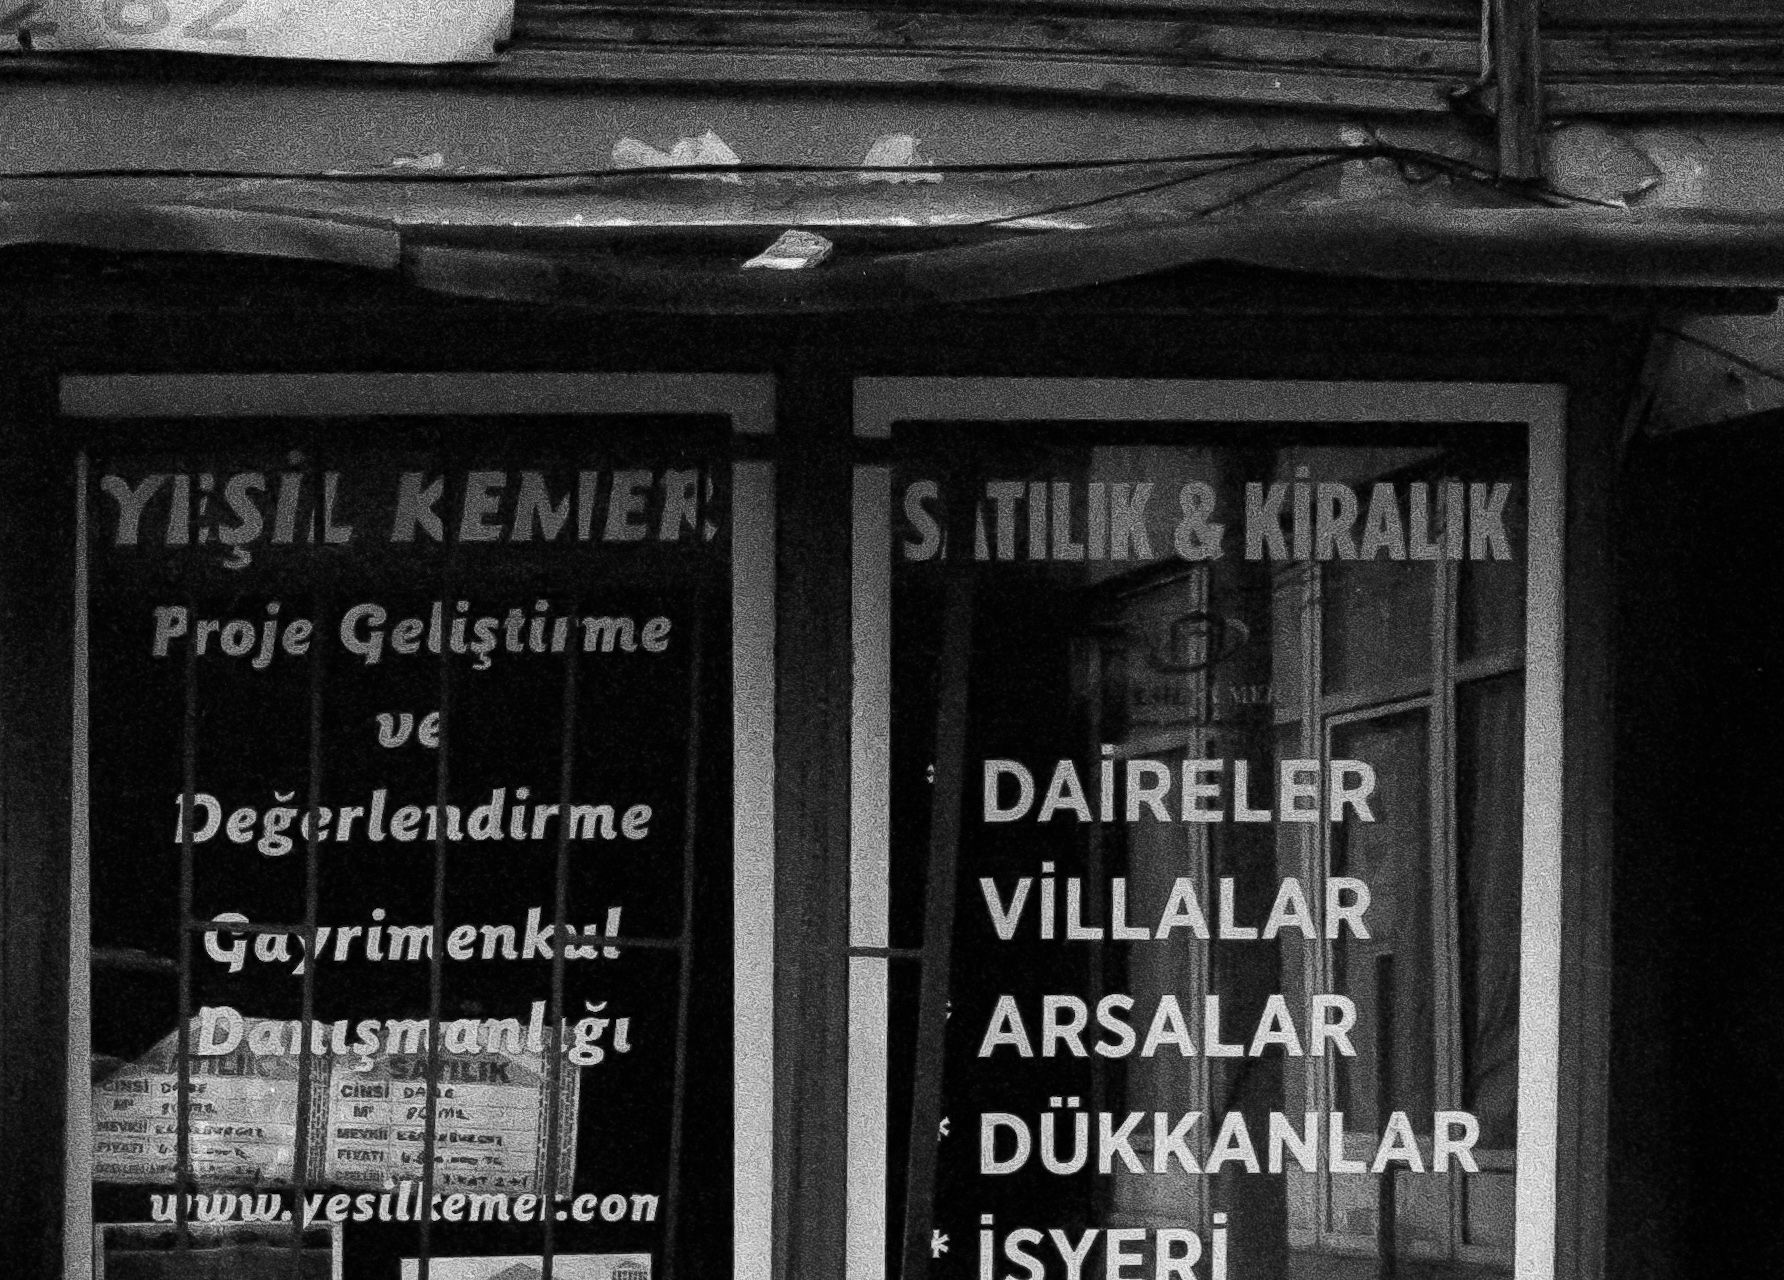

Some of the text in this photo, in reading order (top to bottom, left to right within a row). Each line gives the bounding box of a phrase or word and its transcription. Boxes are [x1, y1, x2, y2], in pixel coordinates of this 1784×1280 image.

[101, 450, 718, 571] YEŞİL KEMER
[1173, 481, 1225, 561] &
[1245, 465, 1513, 561] KİRALIK
[152, 599, 672, 671] Proje Geliştirme
[376, 711, 440, 748] ve
[984, 745, 1377, 823] DAİRELER
[174, 787, 653, 857] Değerlendirme
[979, 861, 1373, 940] VİLLALAR
[197, 1000, 632, 1074] Danışmanlğı
[978, 994, 1358, 1058] ARSALAR
[980, 1097, 1481, 1174] DÜKKANLAR
